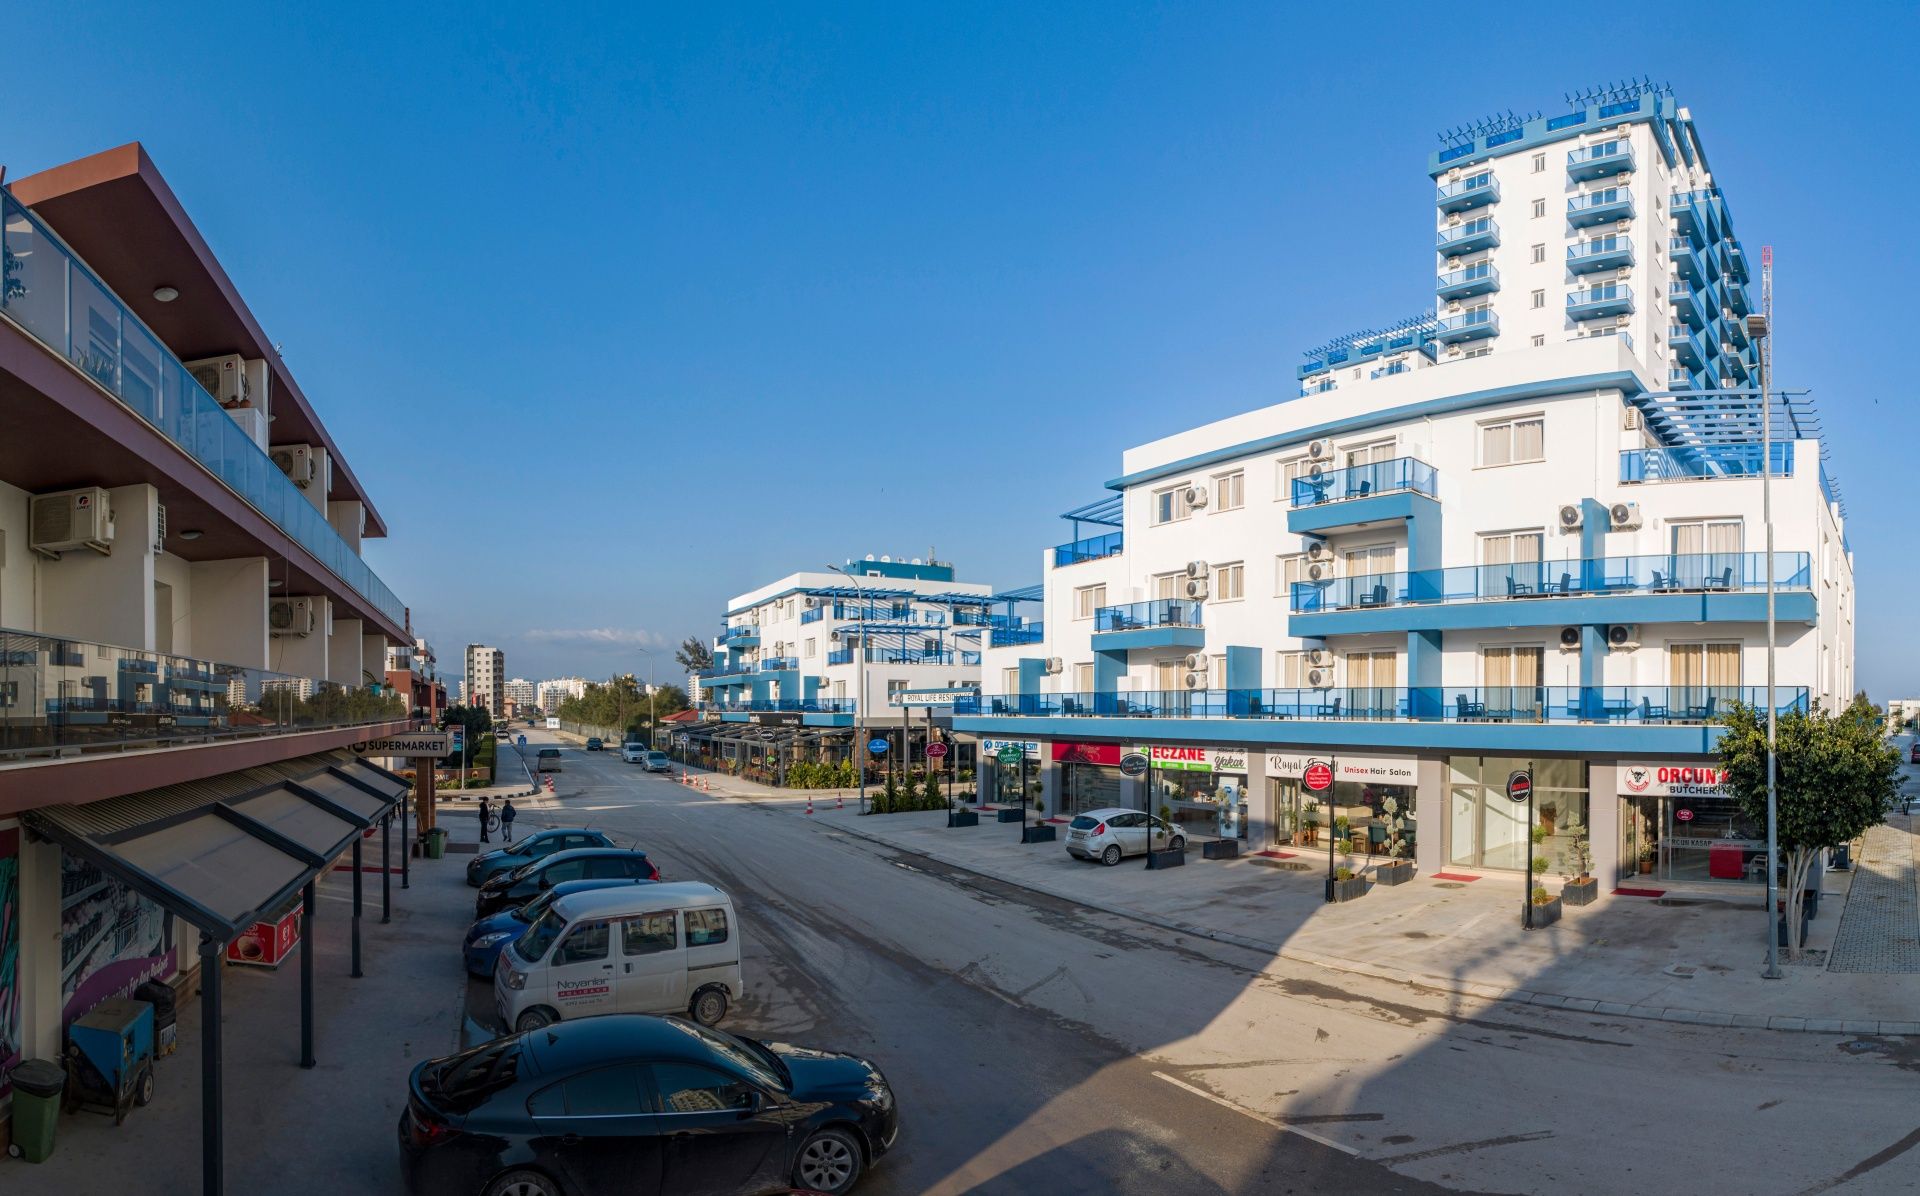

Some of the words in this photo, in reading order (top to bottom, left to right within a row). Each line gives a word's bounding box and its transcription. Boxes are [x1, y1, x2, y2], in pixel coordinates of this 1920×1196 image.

[907, 694, 924, 702] ROYAL
[925, 694, 937, 702] LIFE
[368, 741, 445, 751] SUPERMARKET
[1152, 746, 1206, 761] ECZANE
[1270, 755, 1302, 773] Royal
[1344, 766, 1369, 774] Unisex
[1389, 768, 1412, 776] Salon
[1669, 786, 1716, 795] BUTCHER
[557, 978, 609, 989] Noyanlar
